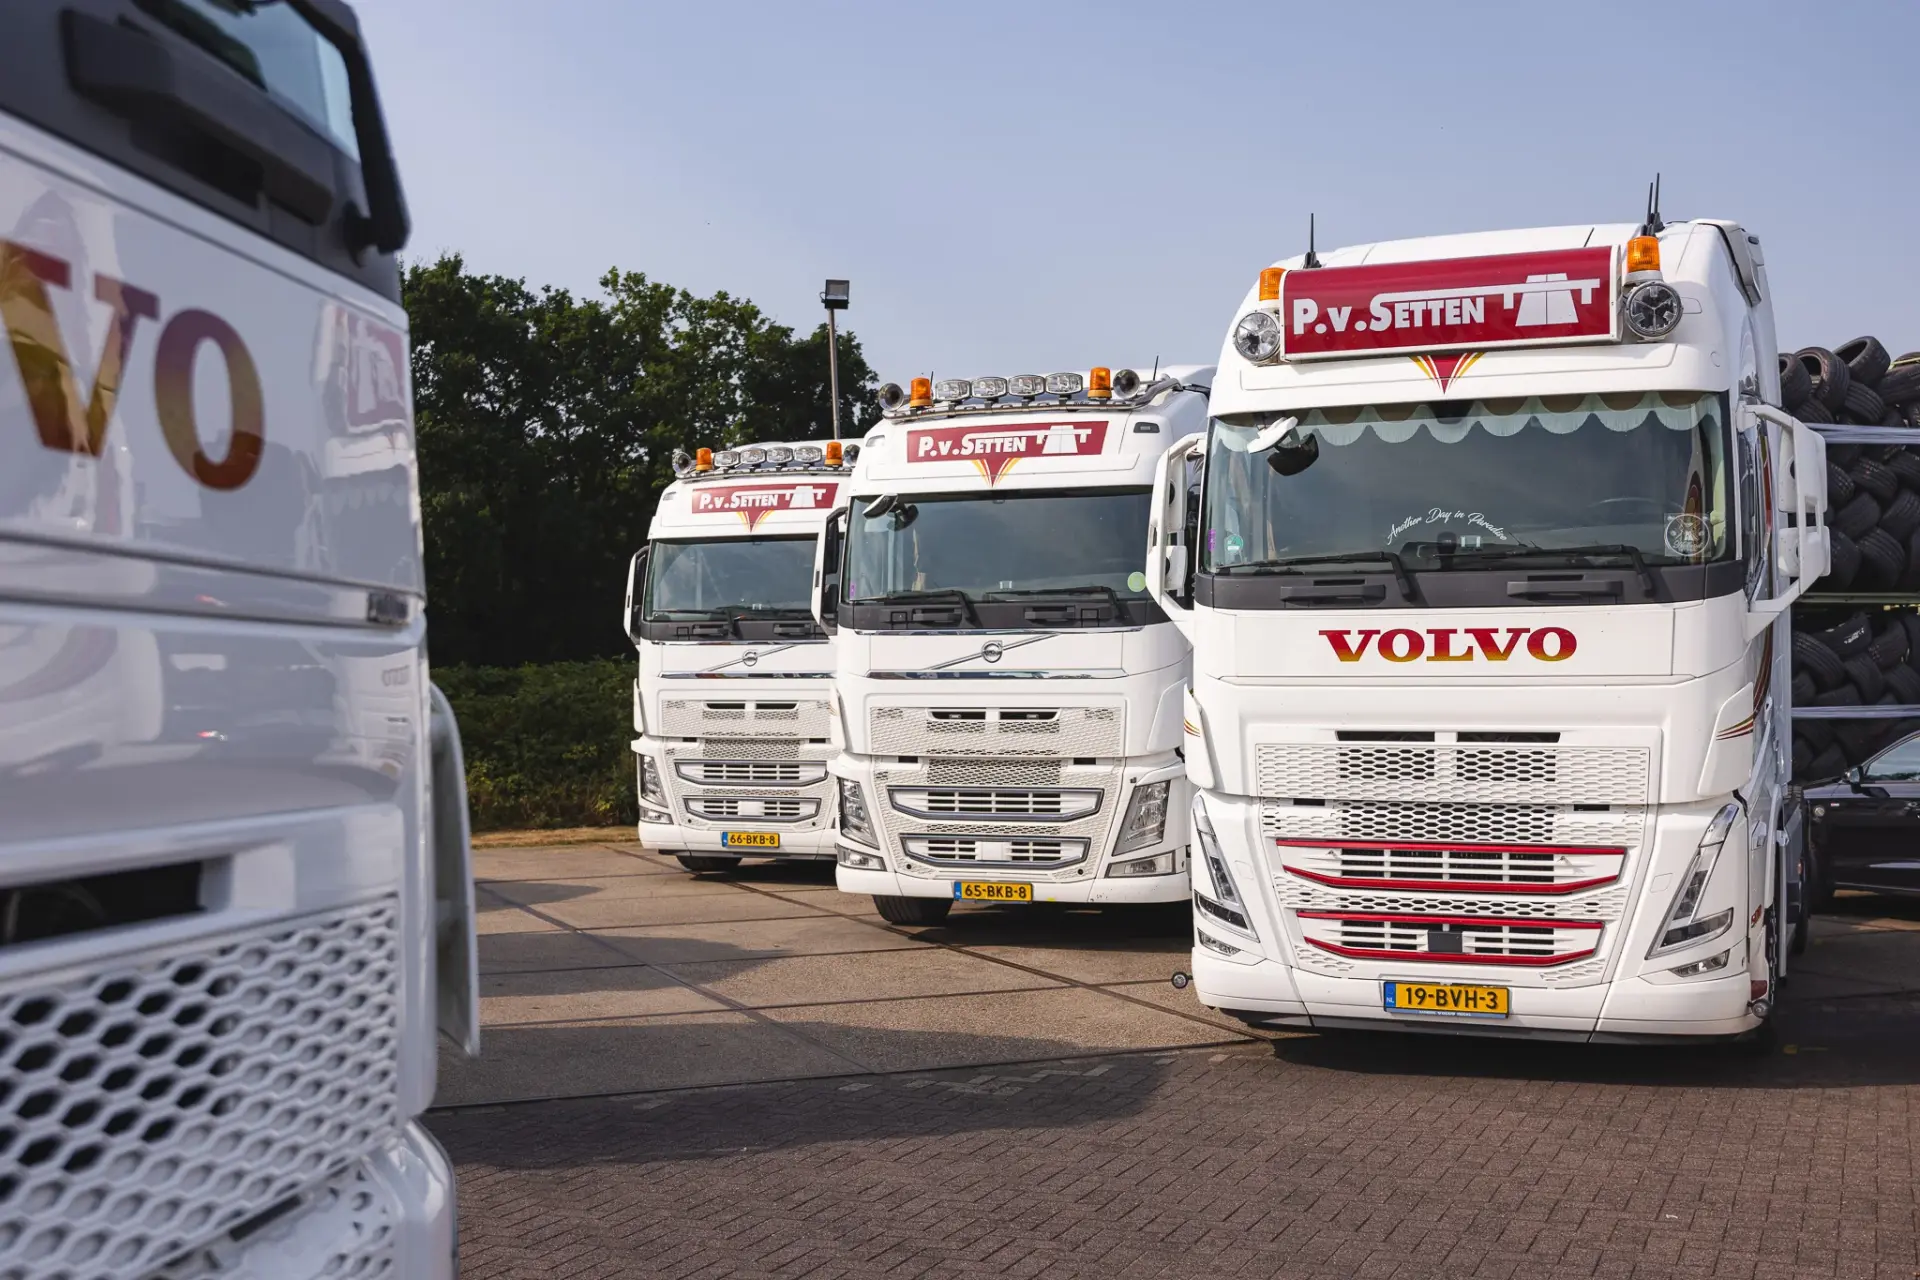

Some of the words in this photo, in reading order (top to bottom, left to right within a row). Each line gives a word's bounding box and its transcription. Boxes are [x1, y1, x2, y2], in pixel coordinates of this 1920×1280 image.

[1387, 516, 1422, 545] Another
[1425, 508, 1452, 523] Day
[1454, 510, 1465, 519] in
[1468, 512, 1507, 540] Paradise
[1319, 626, 1577, 662] VOLVO
[730, 834, 775, 845] 66-BKB-8
[964, 884, 1026, 899] 65-BKB-8
[1405, 987, 1498, 1010] 19-BVH-3
